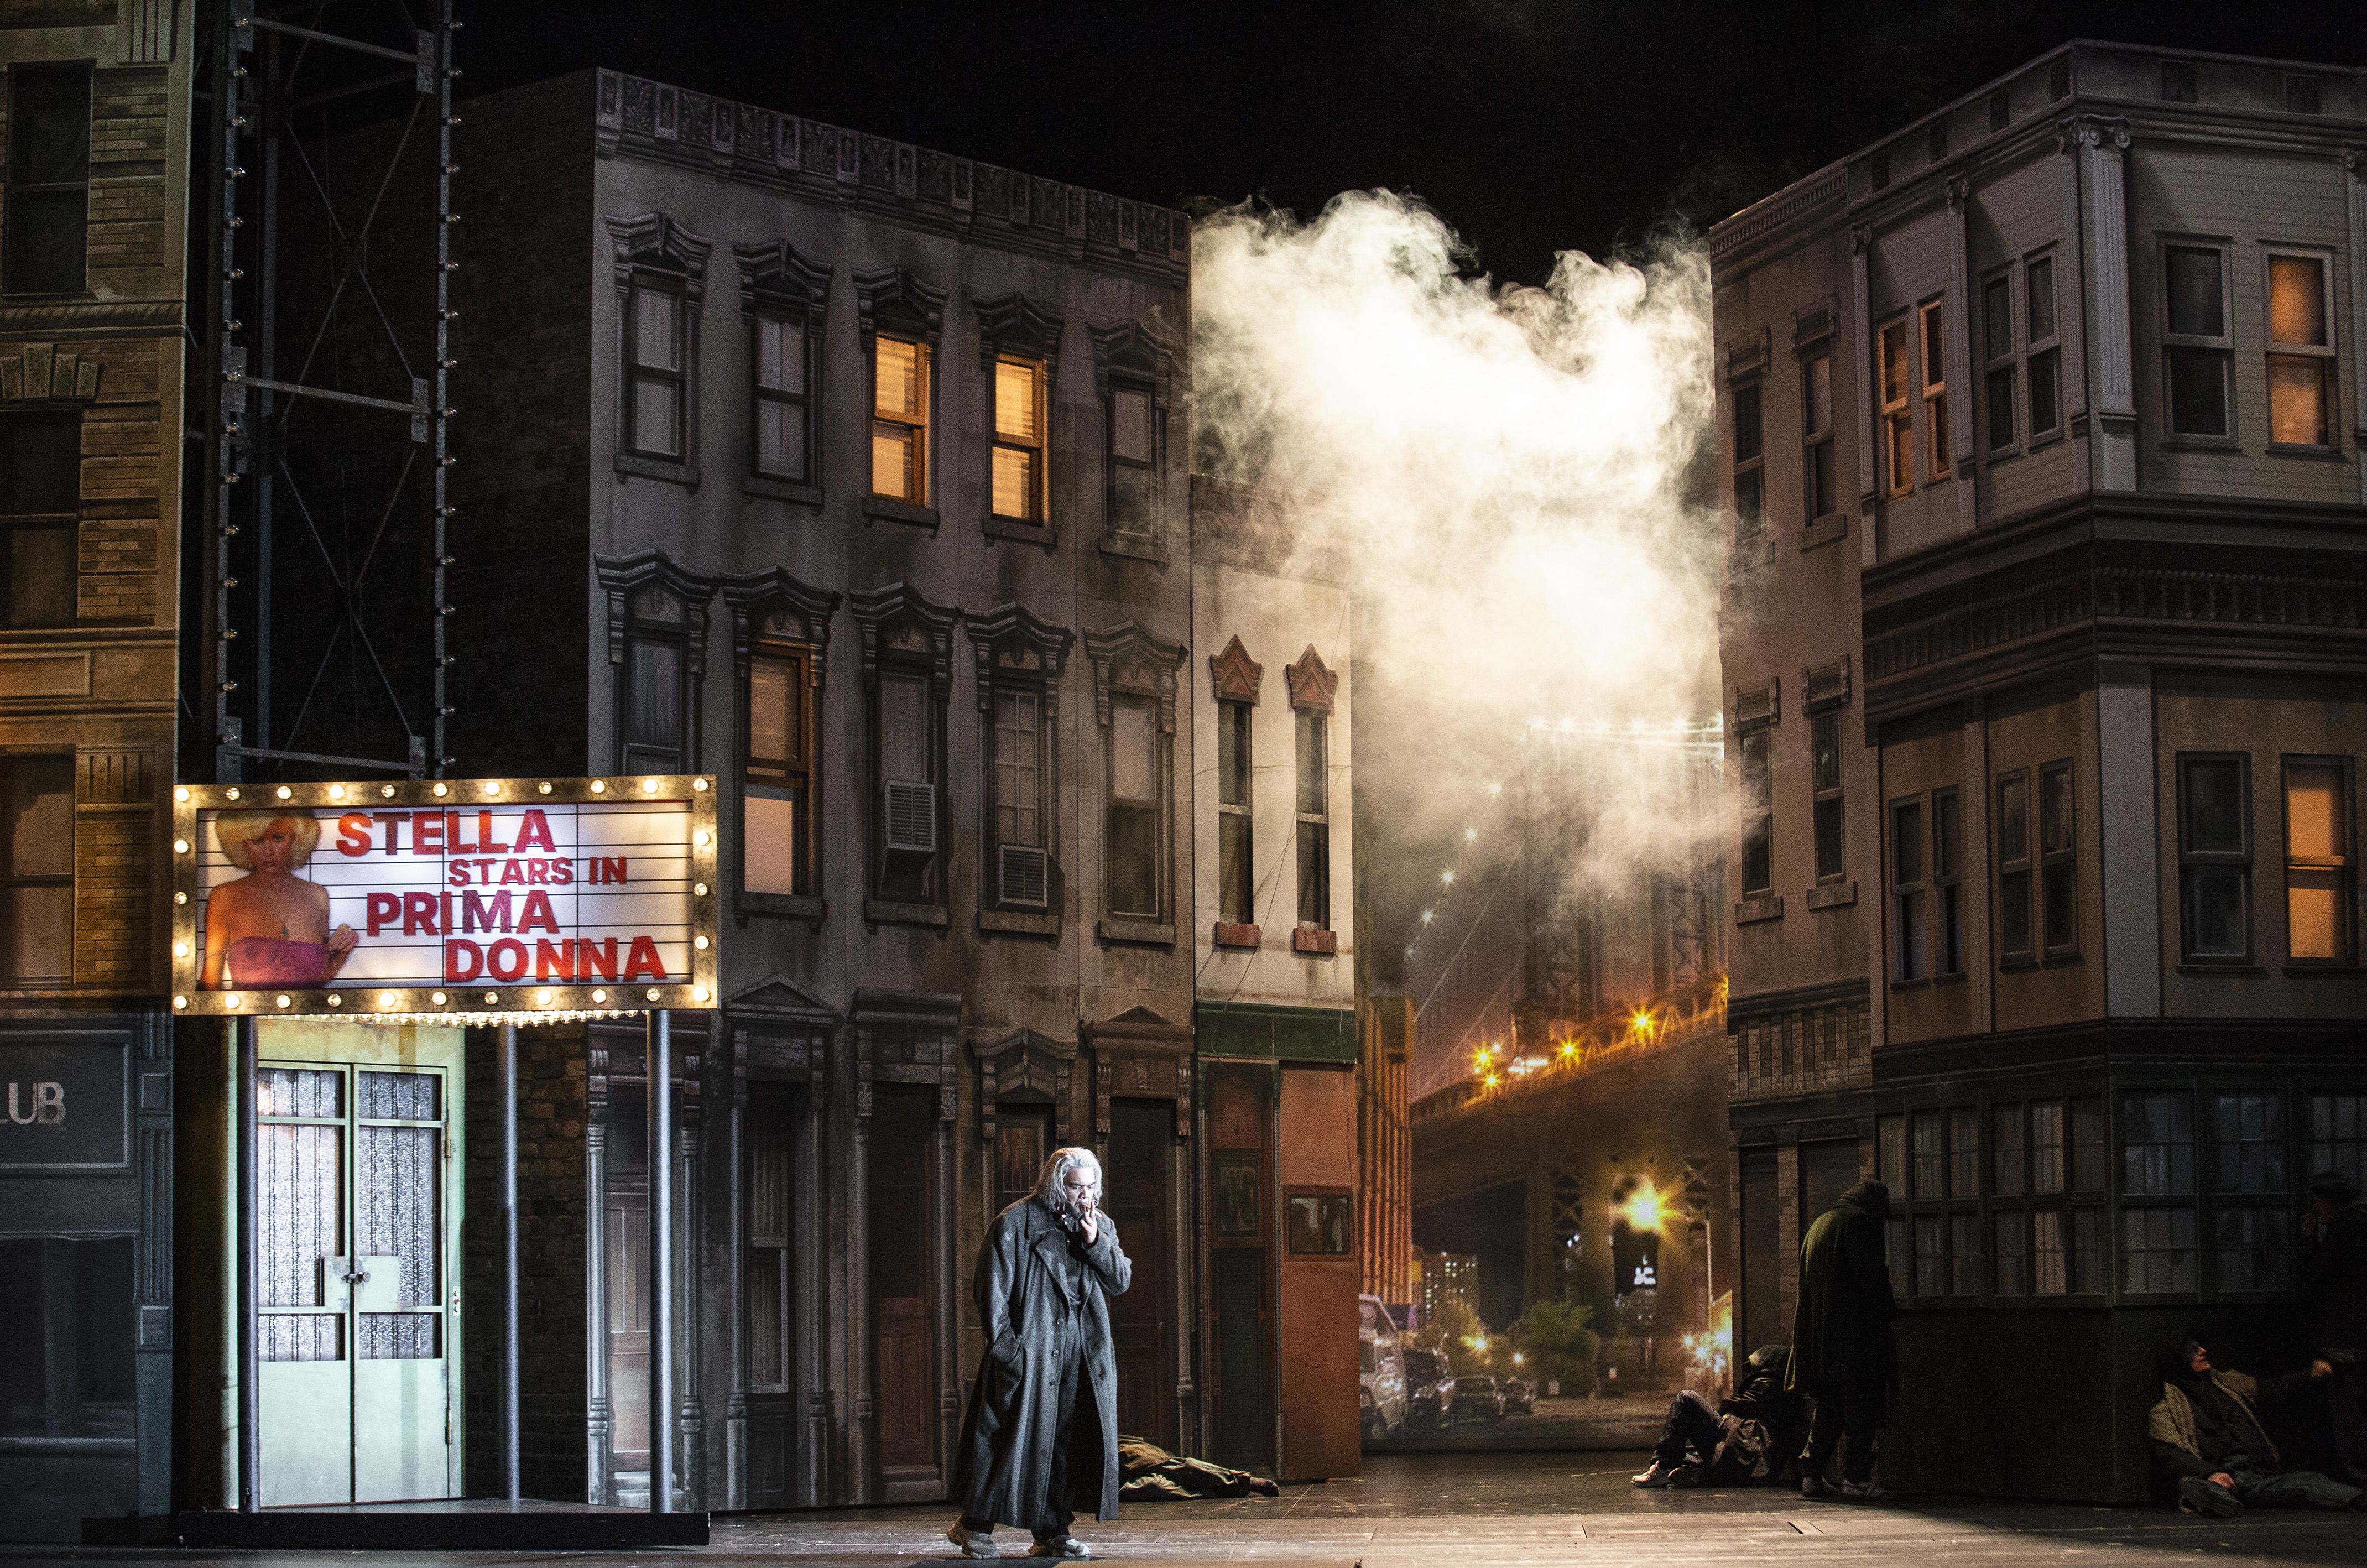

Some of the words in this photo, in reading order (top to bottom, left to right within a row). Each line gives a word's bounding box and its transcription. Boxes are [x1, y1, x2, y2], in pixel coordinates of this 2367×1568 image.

[336, 809, 556, 857] STELLA
[448, 857, 574, 886] STARS
[588, 856, 627, 885] IN
[366, 890, 560, 936] PRIMA
[445, 936, 668, 983] DONNA
